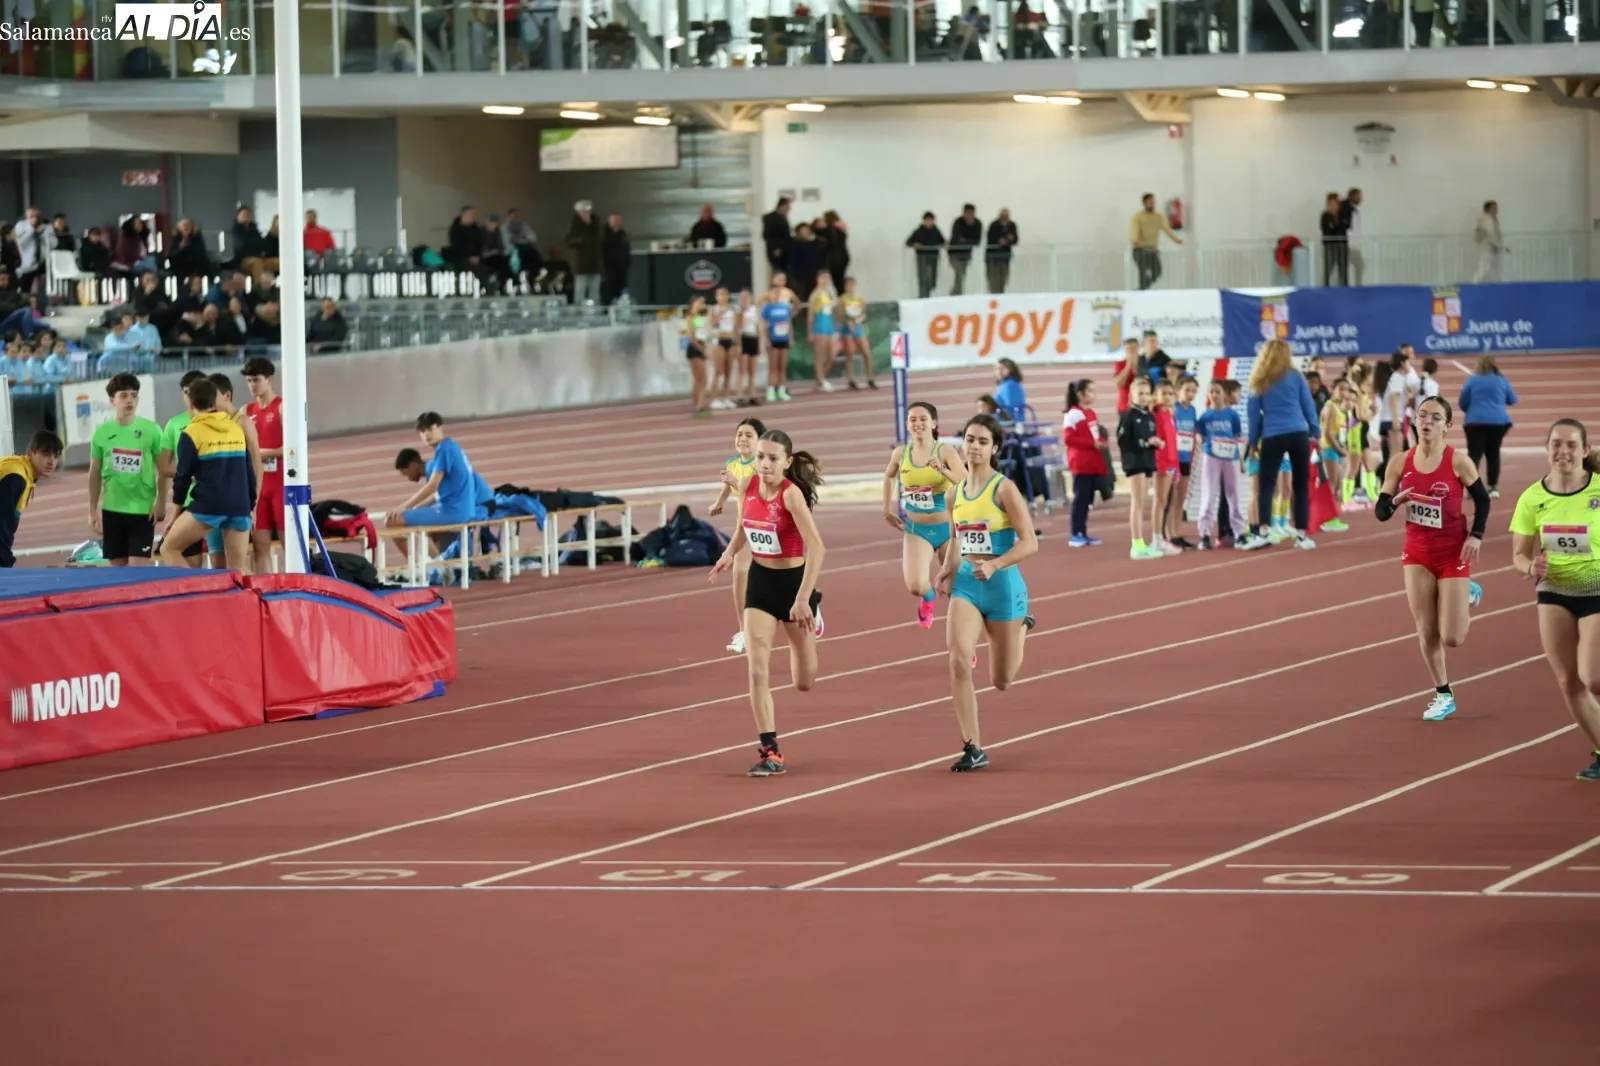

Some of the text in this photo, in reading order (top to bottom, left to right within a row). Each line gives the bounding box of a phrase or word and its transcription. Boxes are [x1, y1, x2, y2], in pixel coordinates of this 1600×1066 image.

[927, 297, 1076, 357] enjoy!
[1293, 322, 1358, 339] Junta de
[1465, 318, 1533, 334] Junta de
[1308, 341, 1320, 355] y
[1322, 338, 1360, 353] León
[1425, 334, 1535, 352] Castilla y León
[114, 455, 140, 467] 1324
[1410, 504, 1440, 519] 1023
[750, 532, 773, 545] 600
[963, 532, 985, 544] 159
[1557, 537, 1578, 548] 63
[31, 671, 121, 722] MONDO
[599, 869, 745, 882] 5
[917, 870, 1057, 883] 4
[1262, 871, 1410, 885] 3
